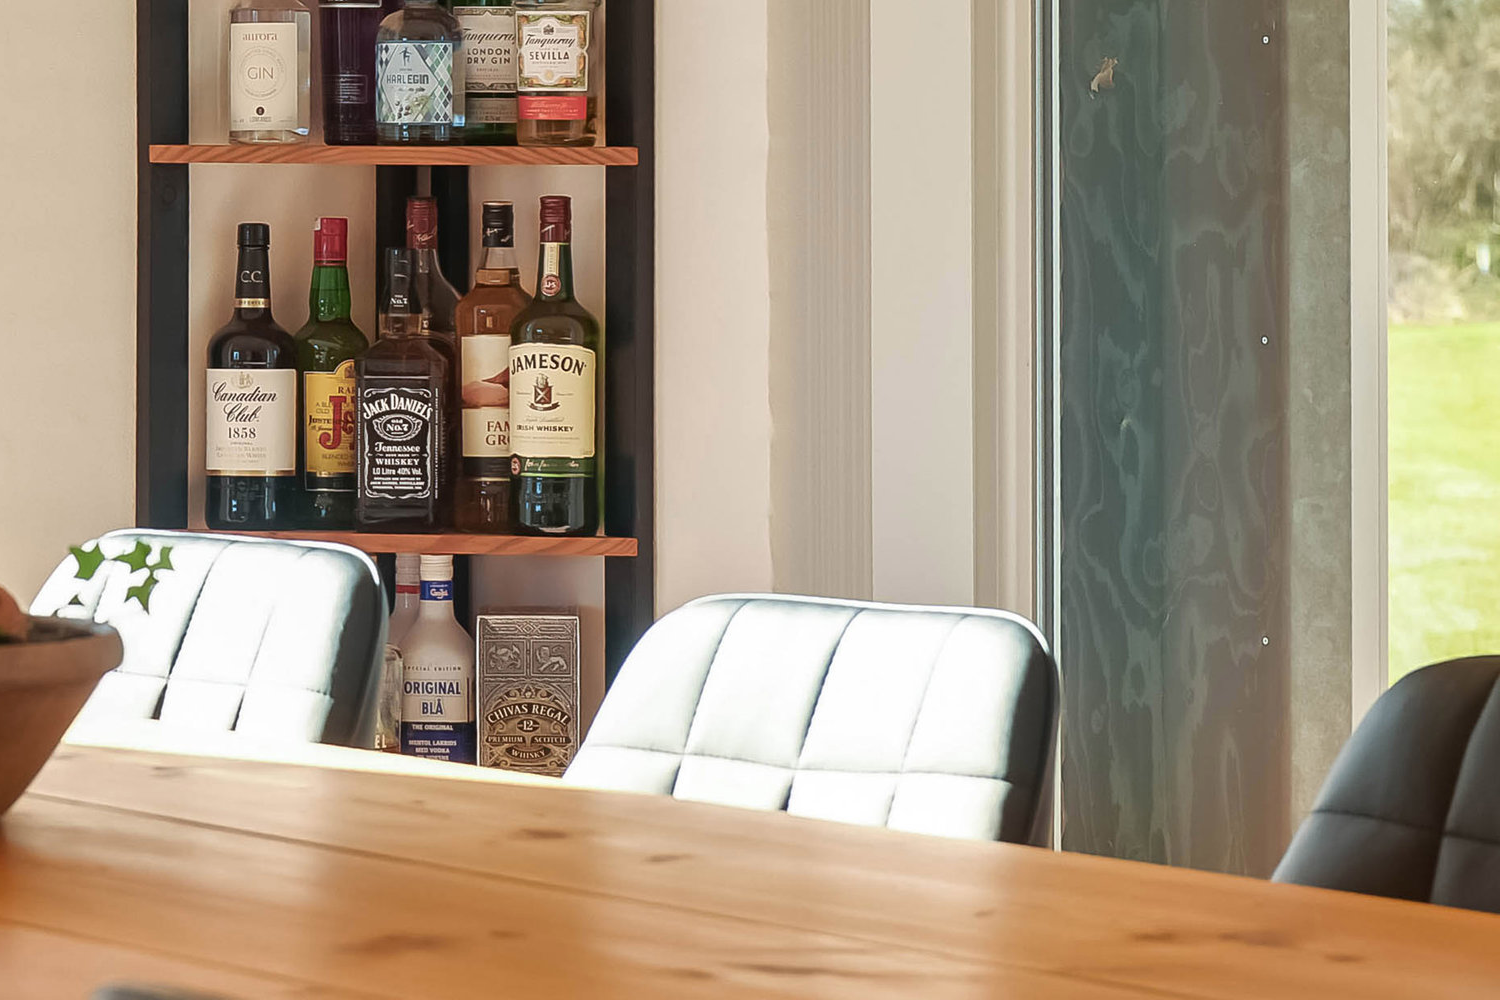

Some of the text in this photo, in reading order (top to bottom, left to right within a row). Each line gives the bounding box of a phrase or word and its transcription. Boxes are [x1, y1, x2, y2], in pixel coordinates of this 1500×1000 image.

[242, 33, 278, 41] aurora
[525, 33, 576, 48] Tanqueray
[529, 51, 570, 60] SEVILLA
[247, 67, 274, 80] GIN
[386, 74, 429, 84] HARLEGIN
[240, 270, 263, 283] C.C.
[511, 354, 585, 376] JAMESON
[212, 381, 277, 402] Canadian
[338, 386, 355, 394] RA
[362, 393, 433, 421] JACK DANIEL'S
[319, 396, 355, 449] J&
[228, 427, 256, 439] 1858
[485, 434, 510, 446] GR
[374, 442, 421, 452] Tennessee
[375, 458, 420, 466] WHISKEY
[404, 681, 461, 695] ORIGINAL
[421, 697, 443, 715] BLÅ
[487, 703, 569, 726] CHIVAS REGAL
[523, 720, 534, 731] 12
[488, 735, 566, 743] PREMIUM SCOTCH
[511, 748, 545, 759] WHISKY
